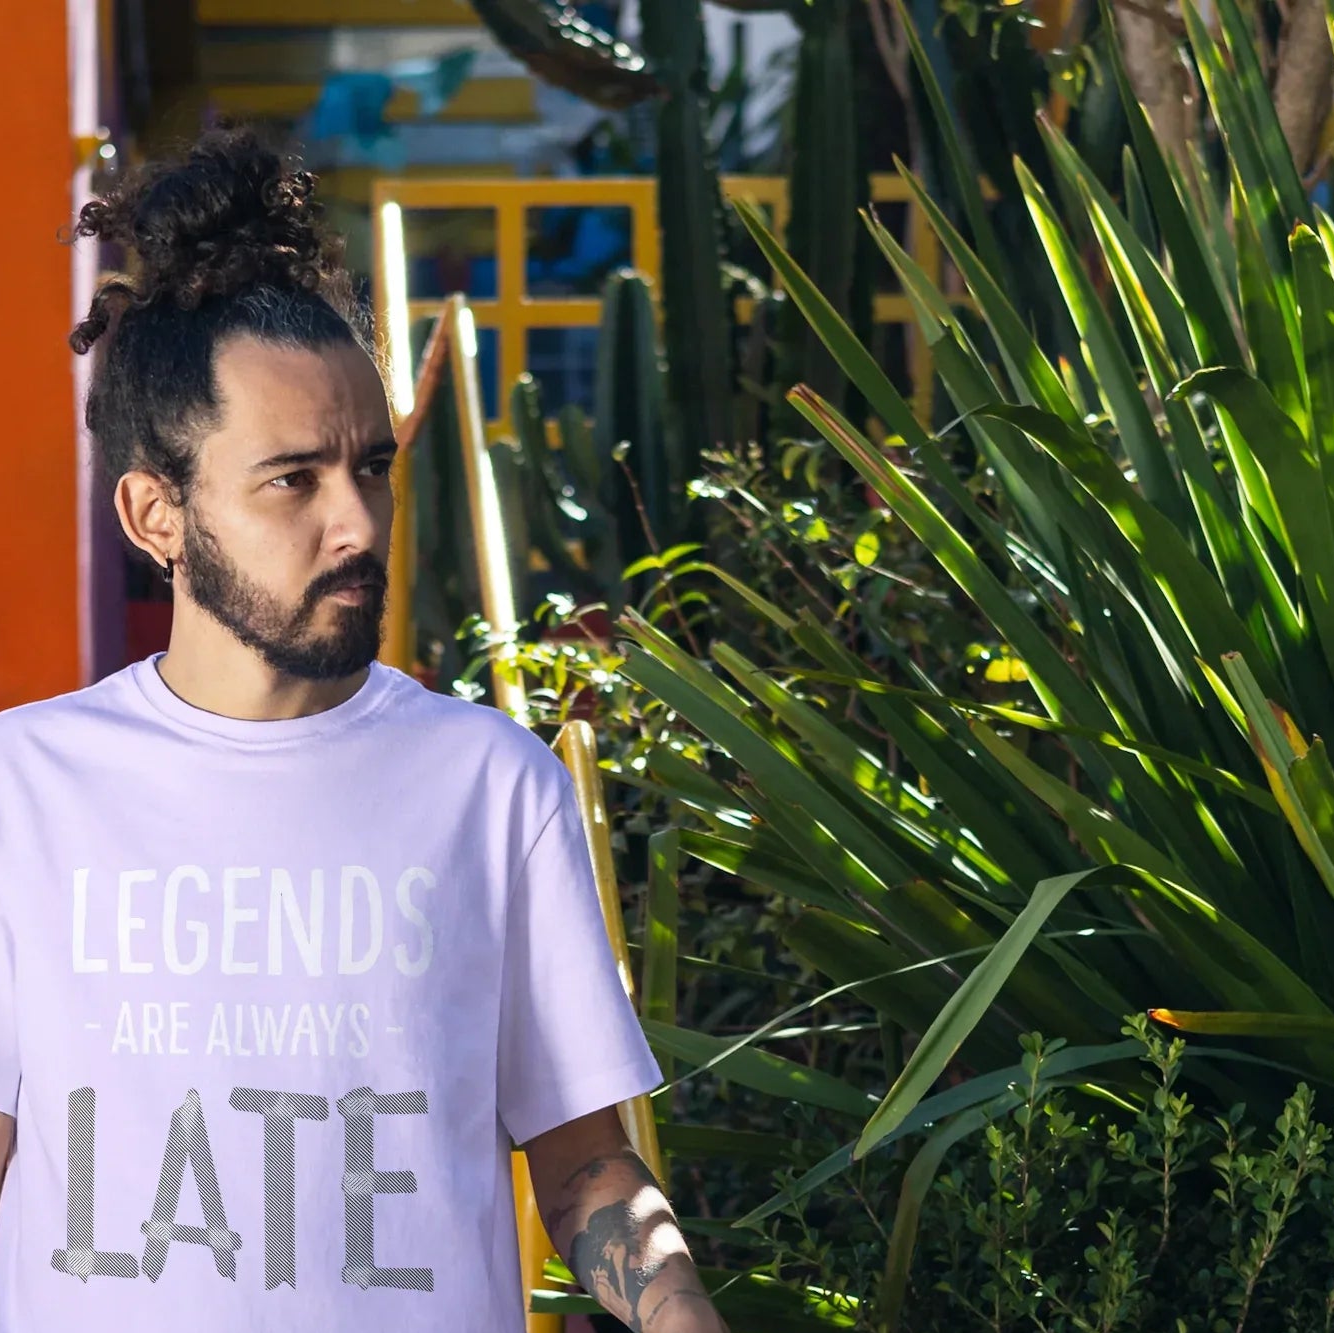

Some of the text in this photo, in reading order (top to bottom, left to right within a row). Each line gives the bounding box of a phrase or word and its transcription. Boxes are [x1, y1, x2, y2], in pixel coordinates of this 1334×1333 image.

[72, 865, 437, 978] LEGENDS
[111, 1001, 371, 1058] ARE ALWAYS
[50, 1086, 435, 1293] LATE
